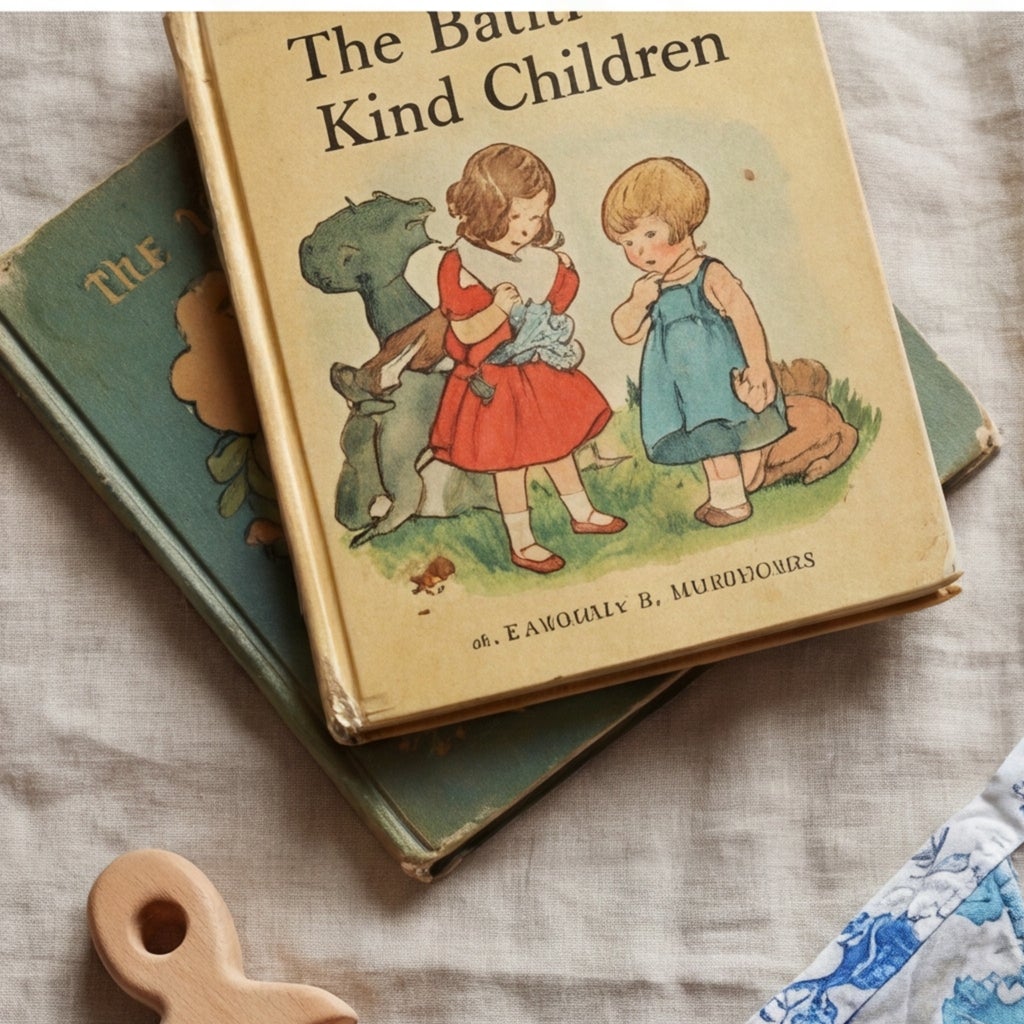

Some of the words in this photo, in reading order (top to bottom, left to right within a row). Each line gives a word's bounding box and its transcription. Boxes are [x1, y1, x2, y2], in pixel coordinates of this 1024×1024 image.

[286, 24, 404, 82] The
[316, 74, 465, 153] Kind
[484, 32, 730, 112] Children
